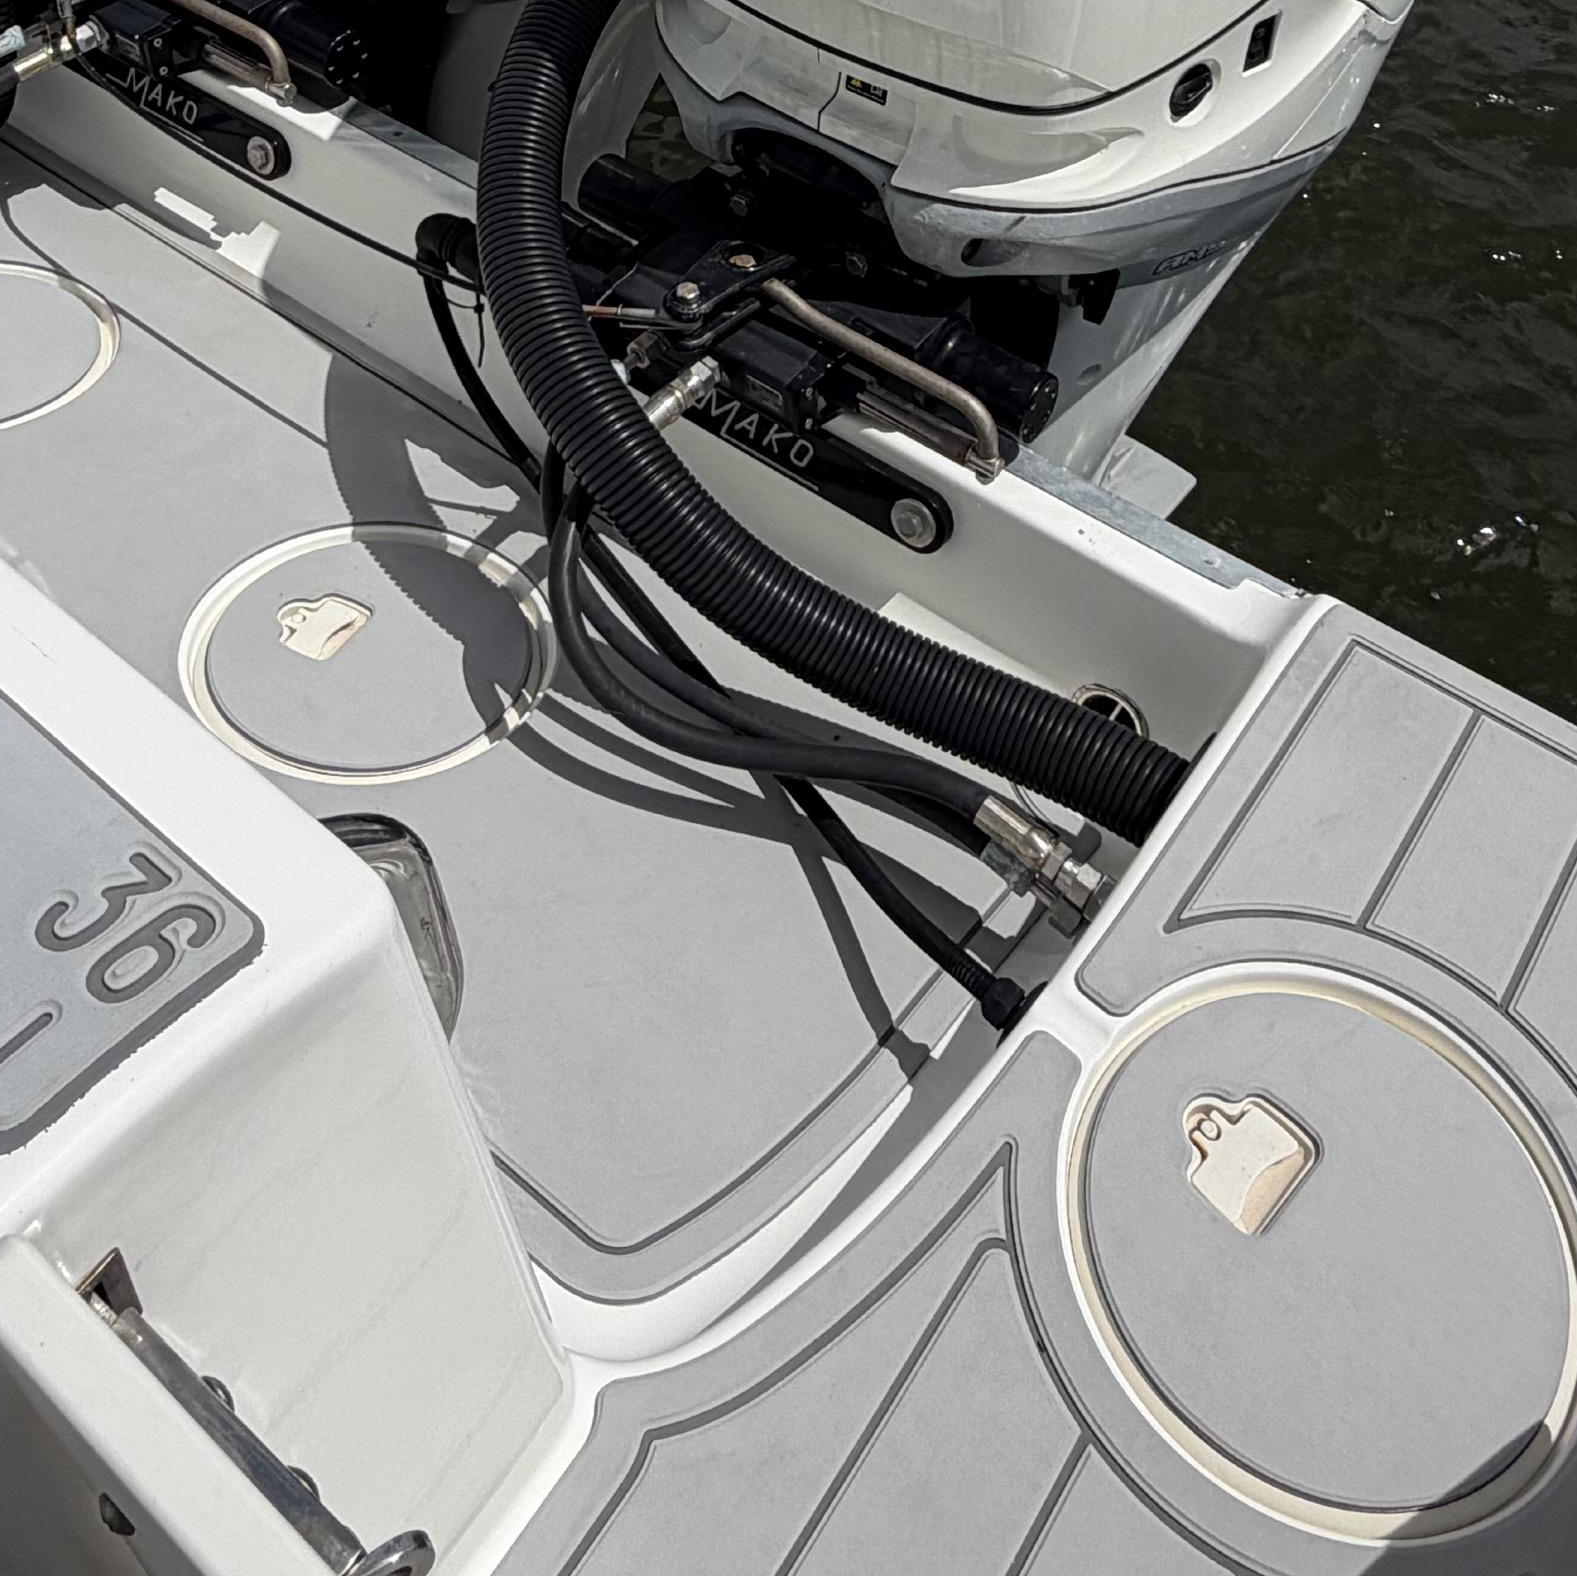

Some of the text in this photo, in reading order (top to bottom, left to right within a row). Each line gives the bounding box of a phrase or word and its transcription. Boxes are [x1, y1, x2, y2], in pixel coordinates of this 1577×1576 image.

[106, 66, 199, 126] MAKO
[695, 387, 816, 469] MAKO
[34, 851, 218, 1005] 36
